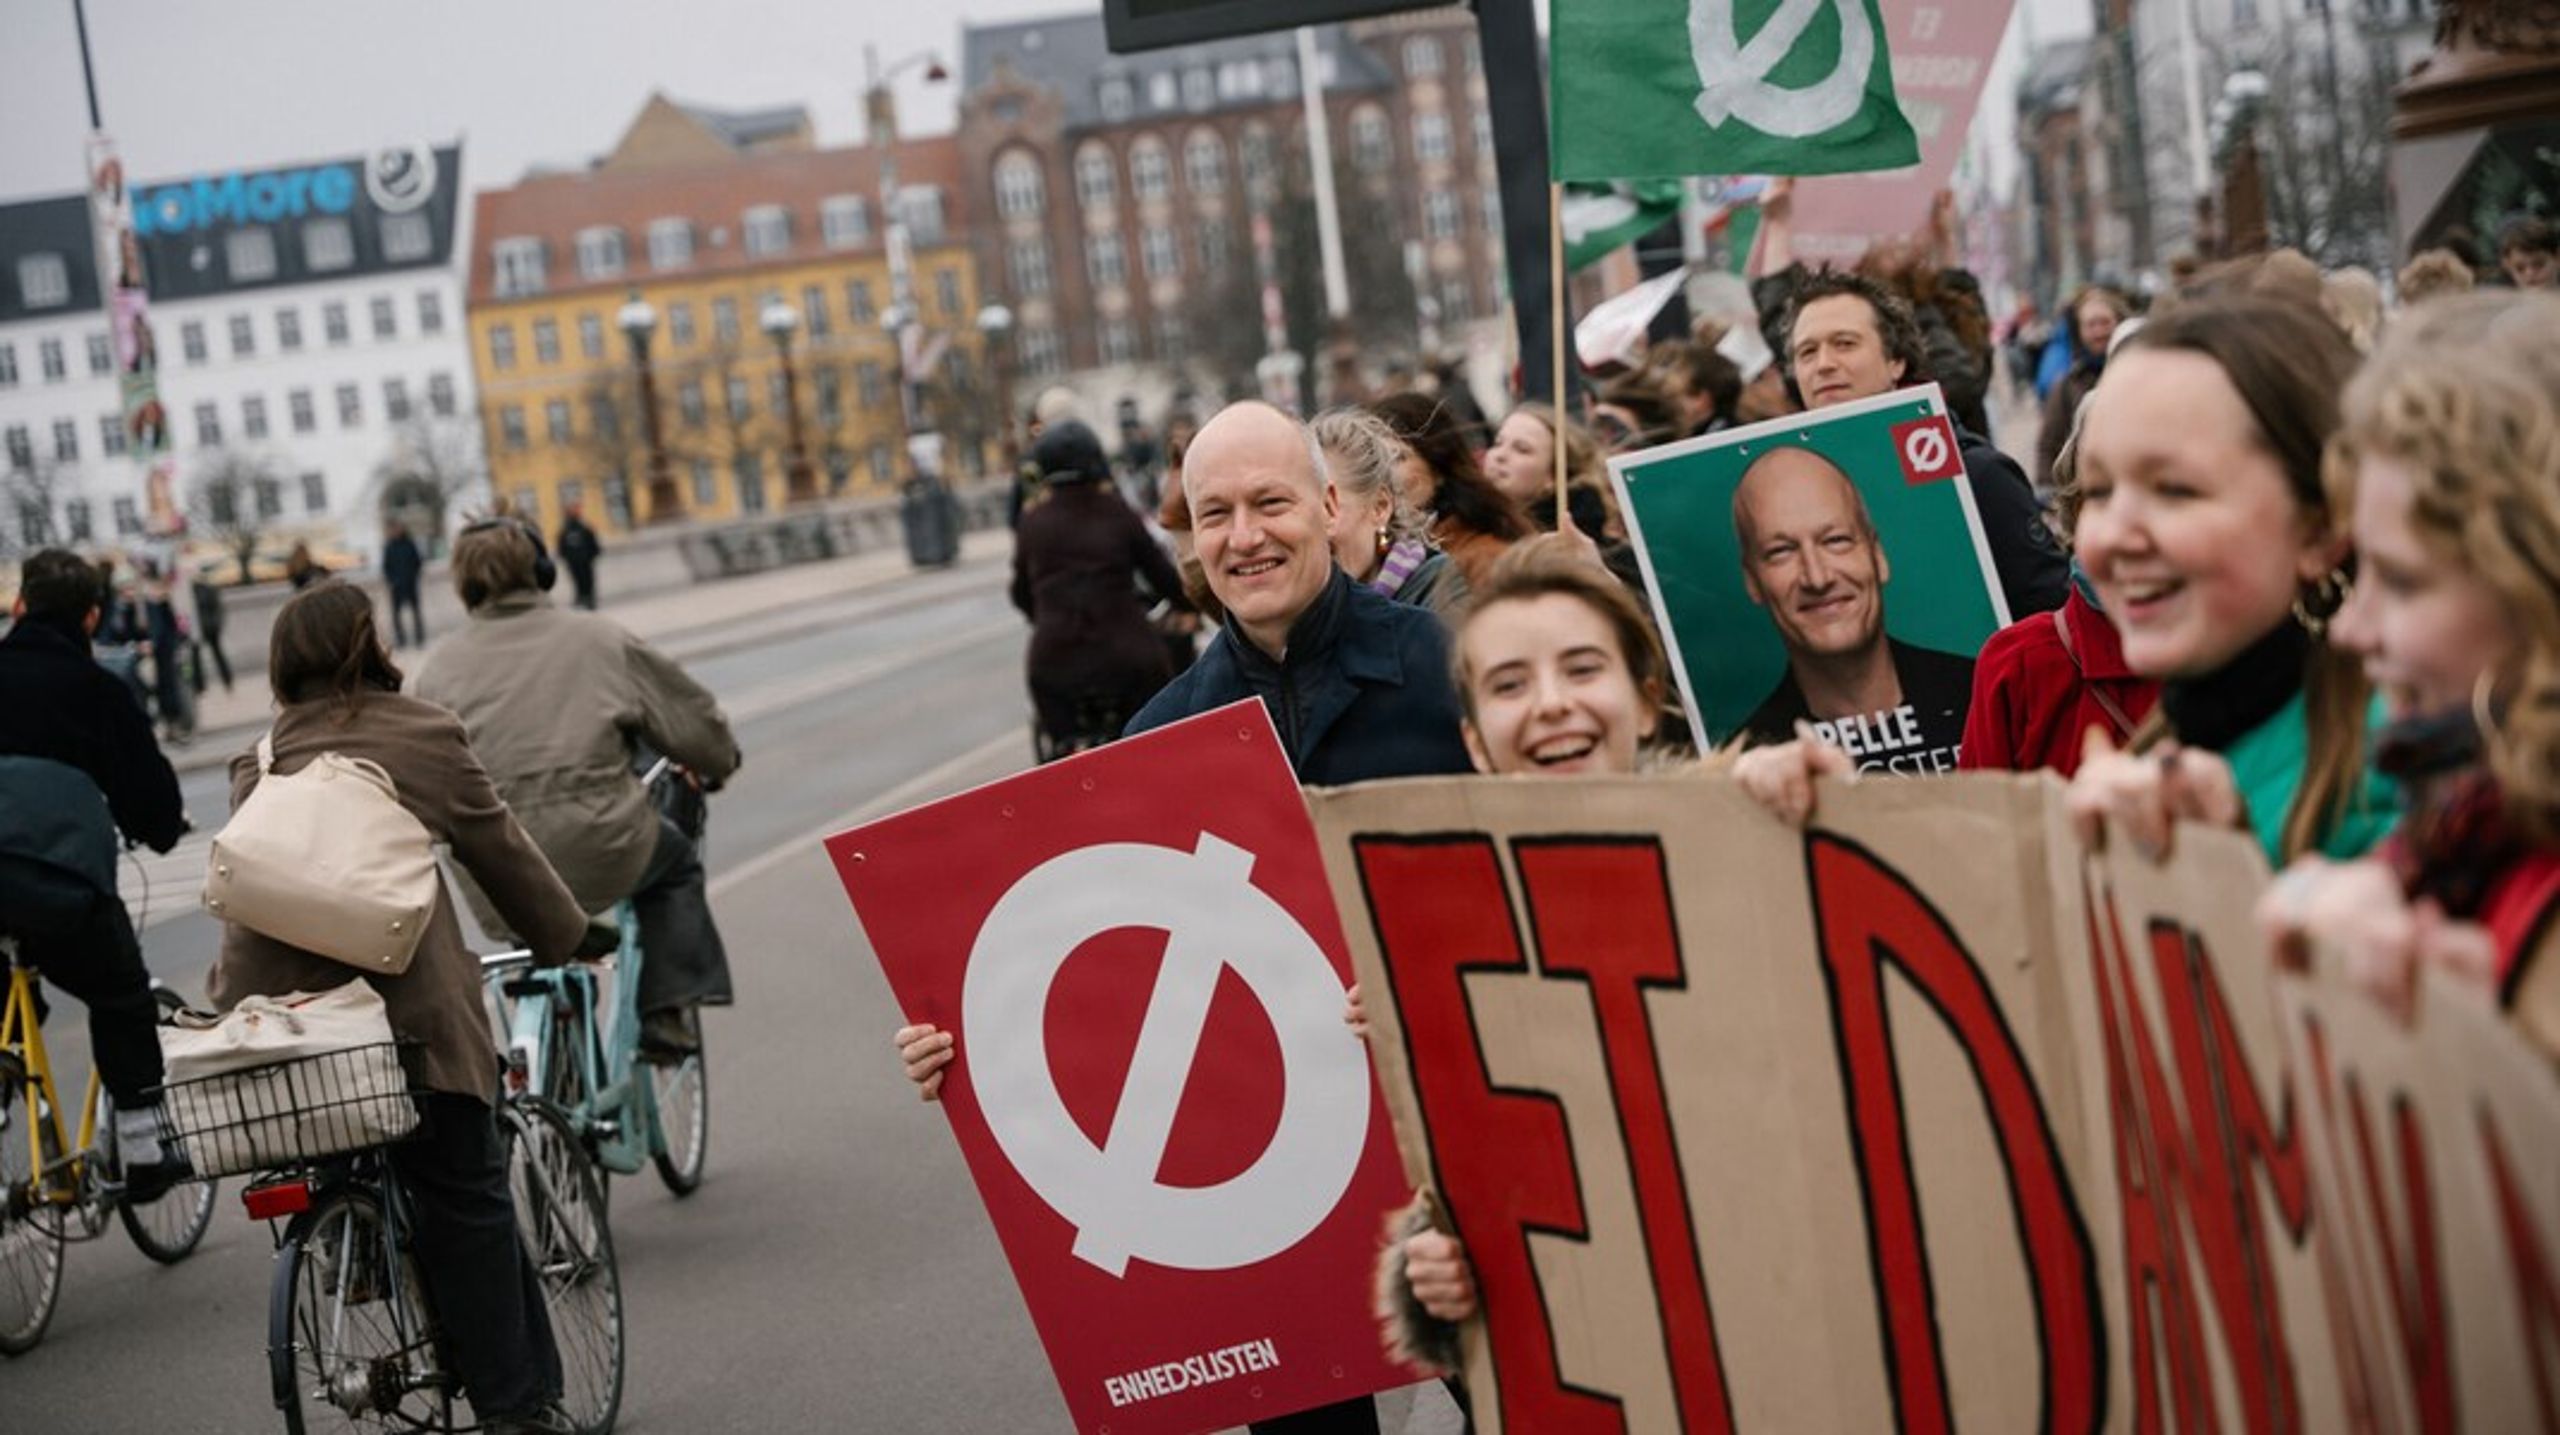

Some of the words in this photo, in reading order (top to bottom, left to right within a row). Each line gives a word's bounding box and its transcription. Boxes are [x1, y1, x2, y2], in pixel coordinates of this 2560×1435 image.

[1905, 426, 1948, 473] Ø
[1813, 705, 1924, 757] PELLE
[962, 830, 1372, 1279] Ø
[1351, 831, 1738, 1435] ET
[1104, 1337, 1281, 1407] ENHEDSLISTEN
